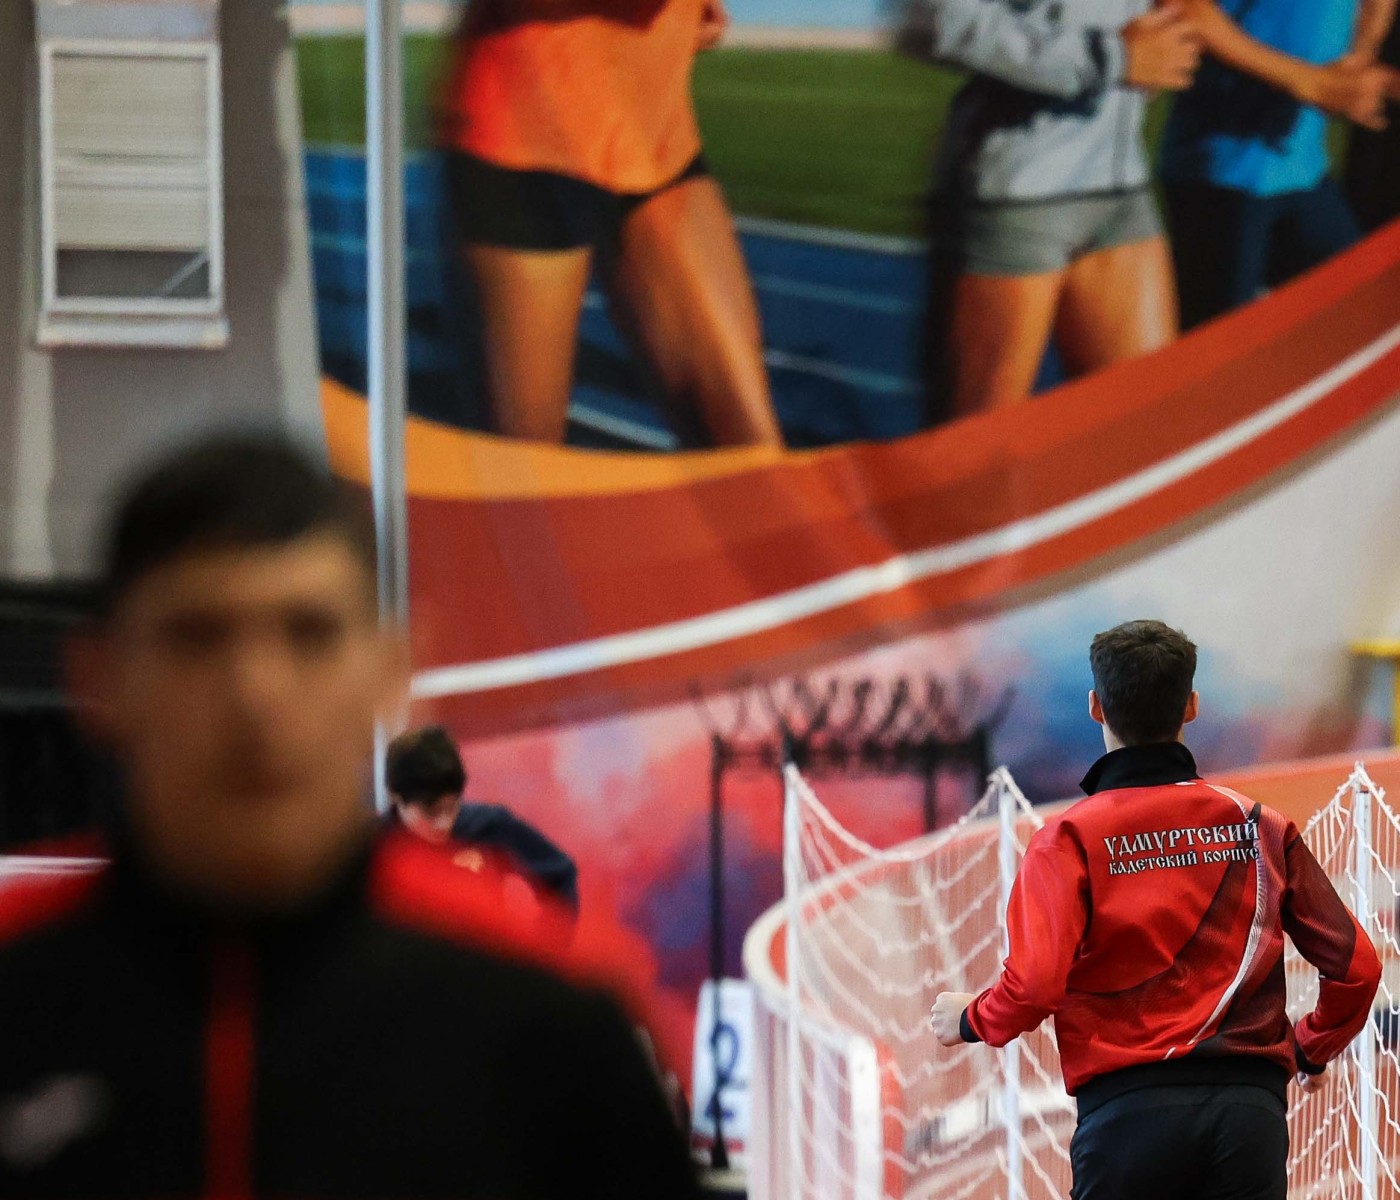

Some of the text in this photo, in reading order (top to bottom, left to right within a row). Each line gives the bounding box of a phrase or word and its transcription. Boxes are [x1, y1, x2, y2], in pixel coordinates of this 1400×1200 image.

[1104, 819, 1259, 859] УДМУРТСКИЙ
[1109, 847, 1260, 875] КАДЕТСКИЙ КОРПУС
